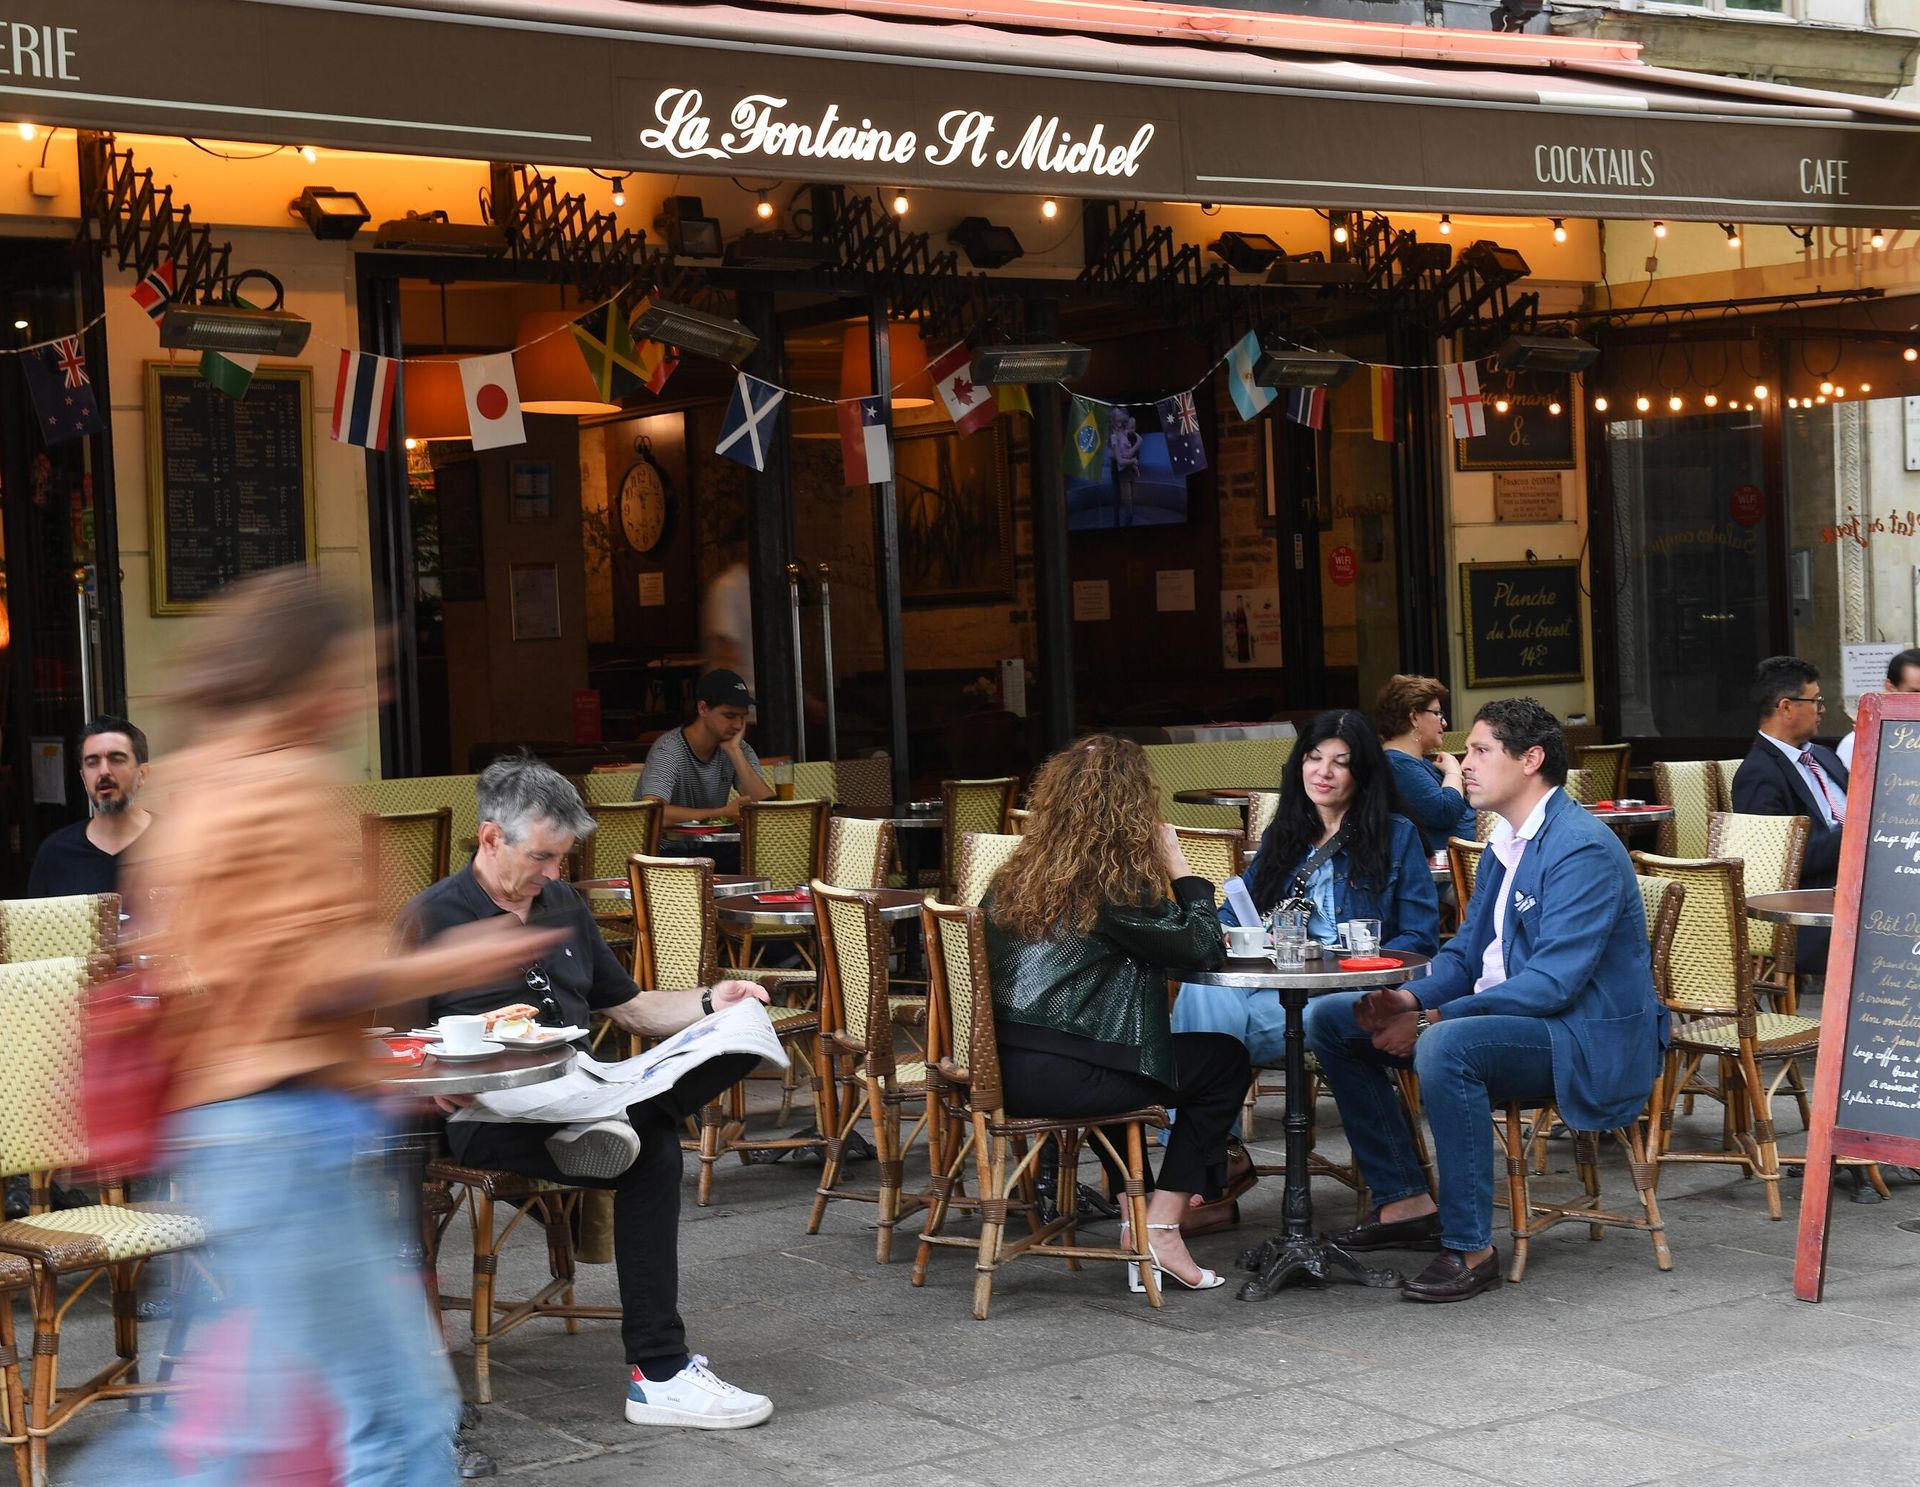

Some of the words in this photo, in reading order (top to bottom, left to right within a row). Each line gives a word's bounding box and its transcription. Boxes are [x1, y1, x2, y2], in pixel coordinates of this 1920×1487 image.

[640, 87, 732, 160] La
[721, 94, 917, 164] Fontaine
[925, 109, 995, 168] St
[996, 114, 1155, 178] Michel
[1535, 144, 1655, 187] COCKTAILS
[1799, 158, 1849, 195] CAFE
[1493, 581, 1557, 608] Planche
[1486, 621, 1504, 640] du
[1507, 614, 1573, 639] Sud-Ouest
[1864, 909, 1901, 932] Petit
